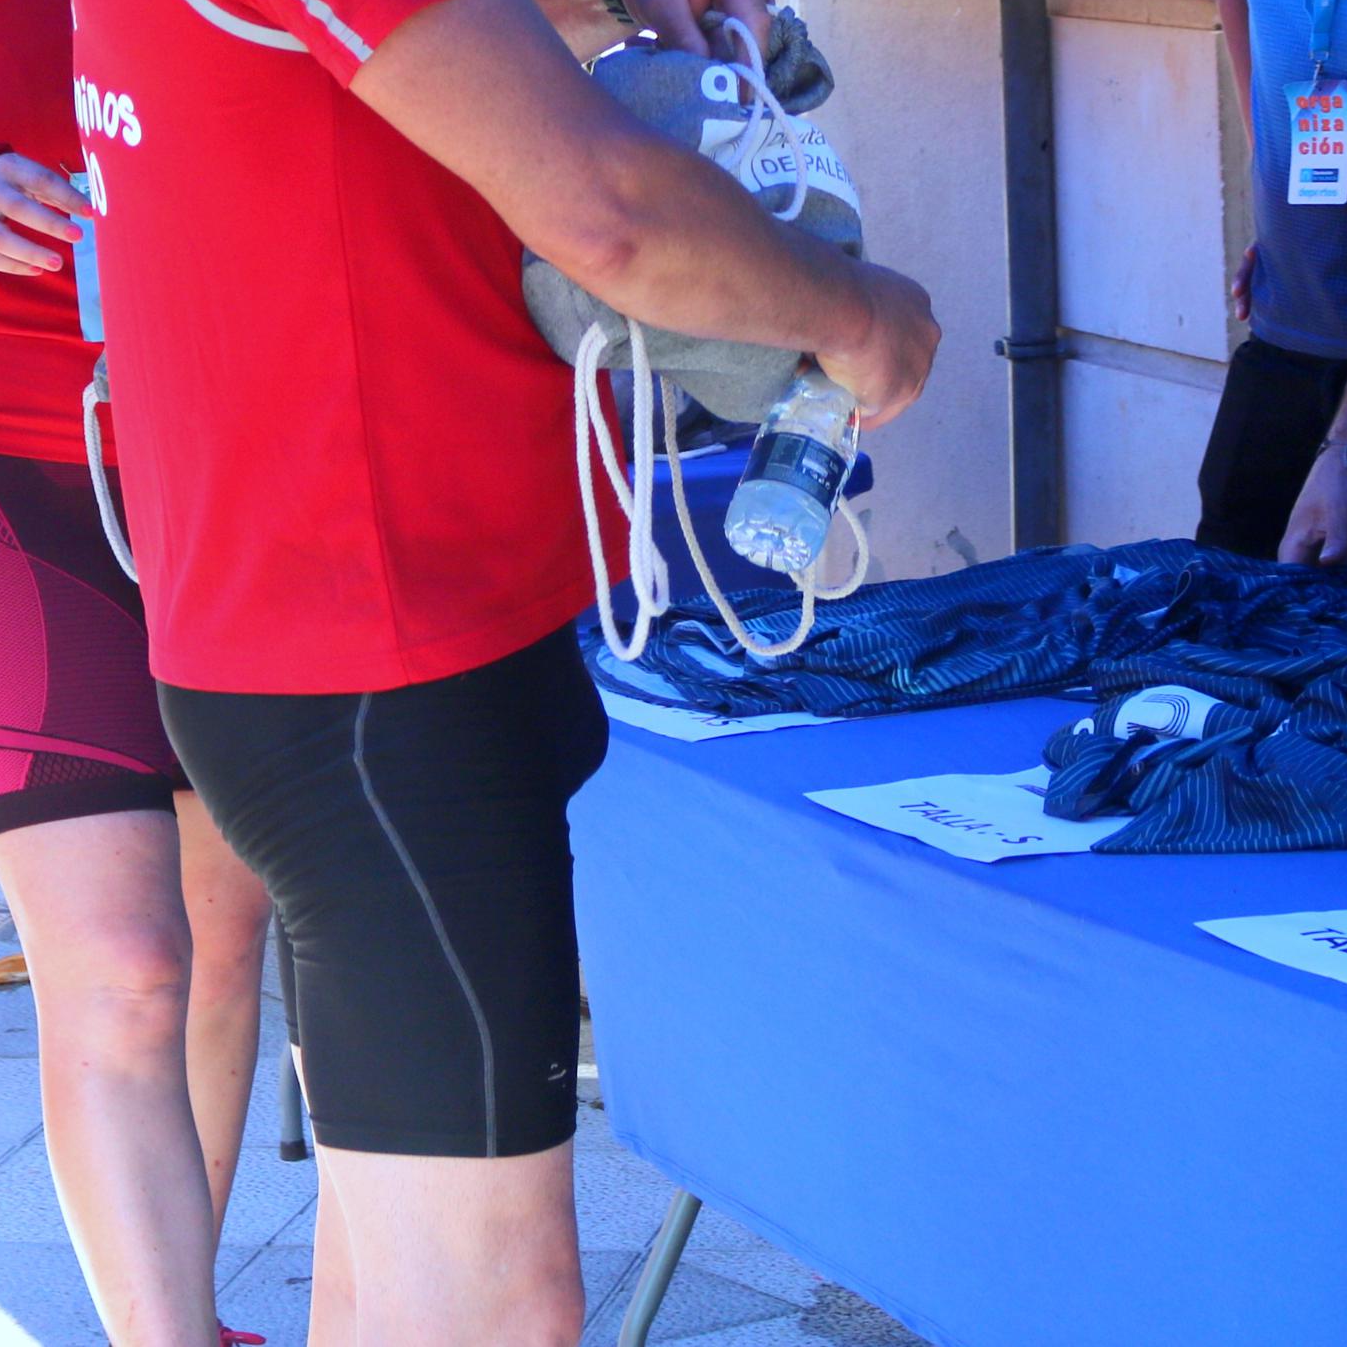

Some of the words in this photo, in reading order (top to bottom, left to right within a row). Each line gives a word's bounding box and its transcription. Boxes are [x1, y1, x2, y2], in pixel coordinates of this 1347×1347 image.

[1295, 95, 1344, 113] orga
[1297, 113, 1345, 132] niza
[1298, 137, 1345, 155] ción
[761, 156, 797, 174] DE
